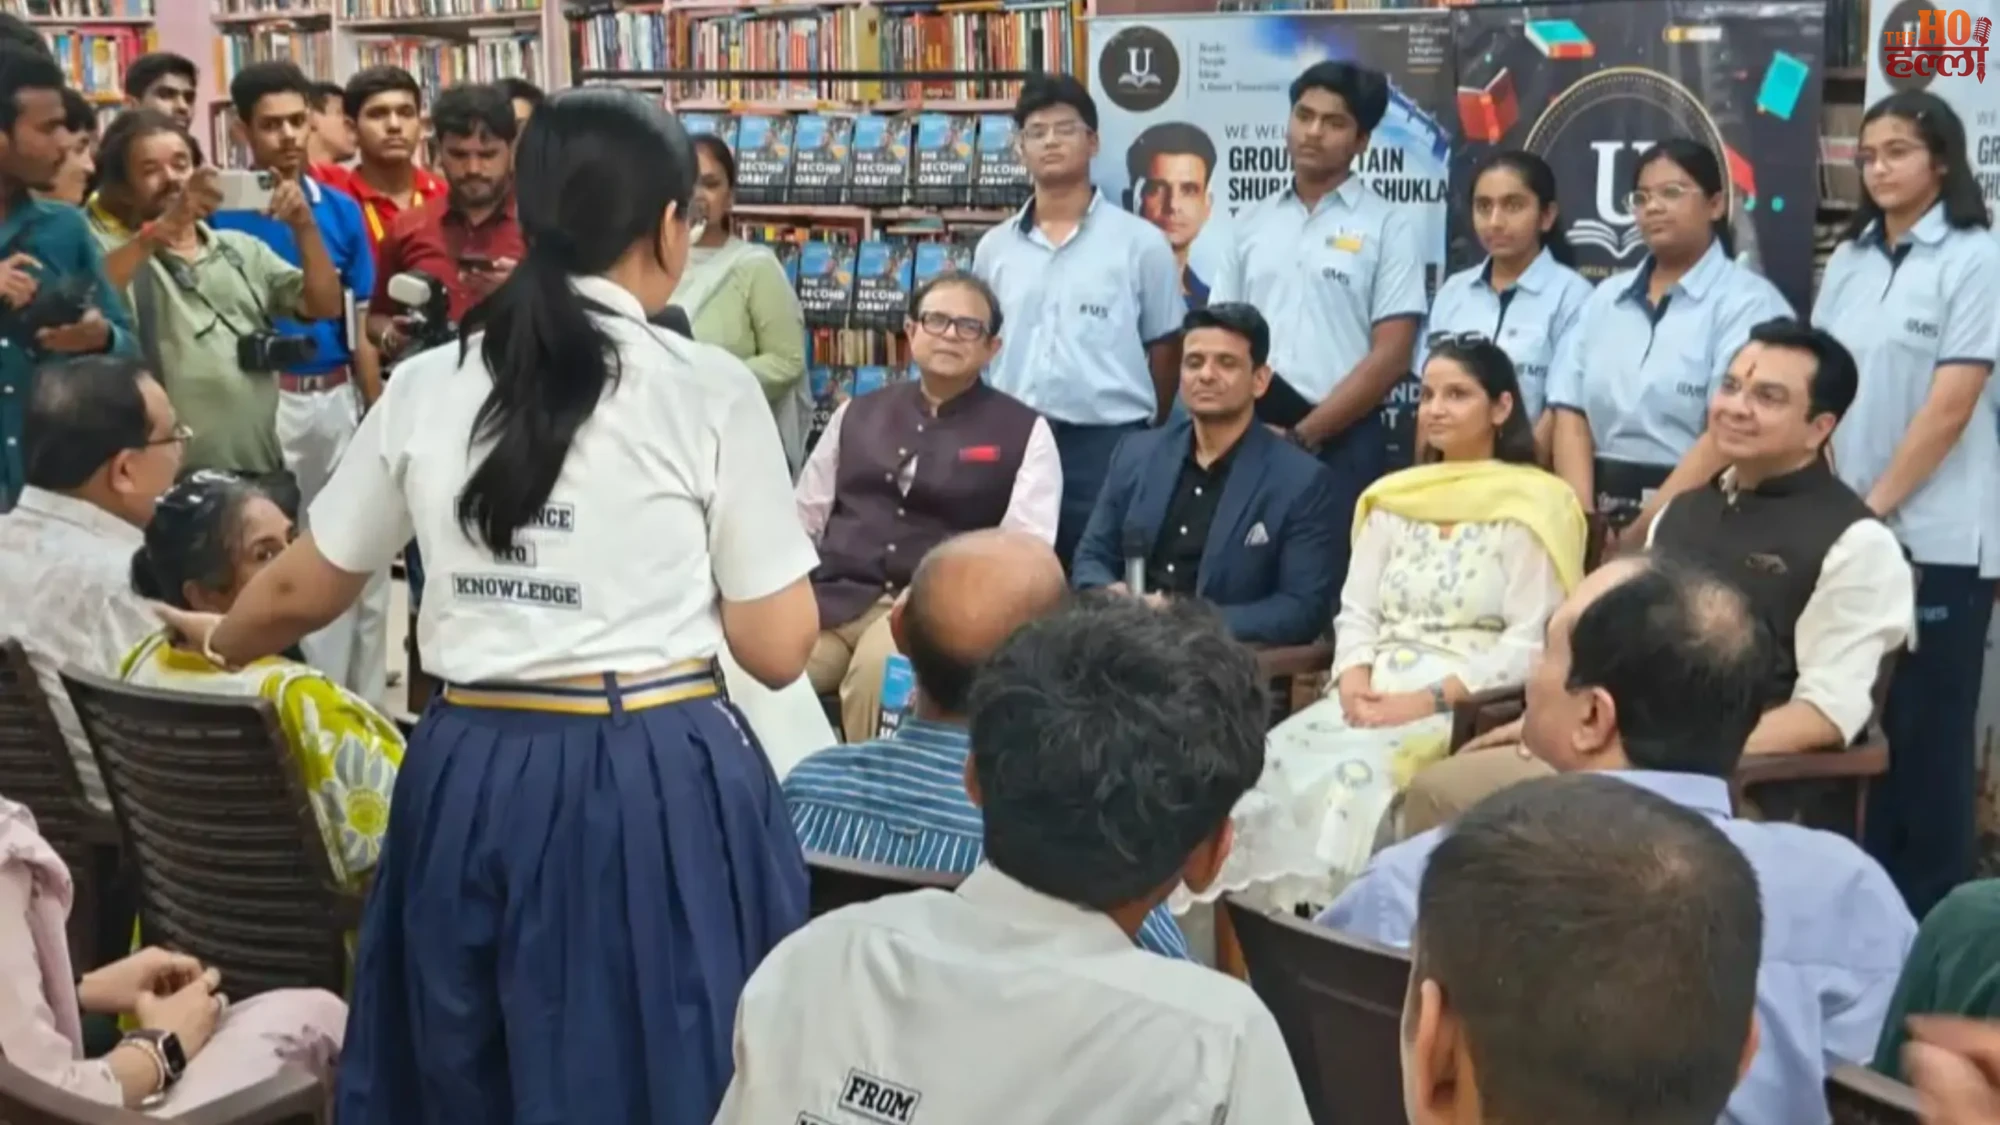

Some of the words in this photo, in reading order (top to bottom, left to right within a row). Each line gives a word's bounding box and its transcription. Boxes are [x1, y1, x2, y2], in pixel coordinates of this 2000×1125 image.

[1127, 47, 1154, 77] U
[1225, 125, 1249, 139] WE
[456, 577, 578, 605] KNOWLEDGE
[845, 1075, 914, 1123] FROM
